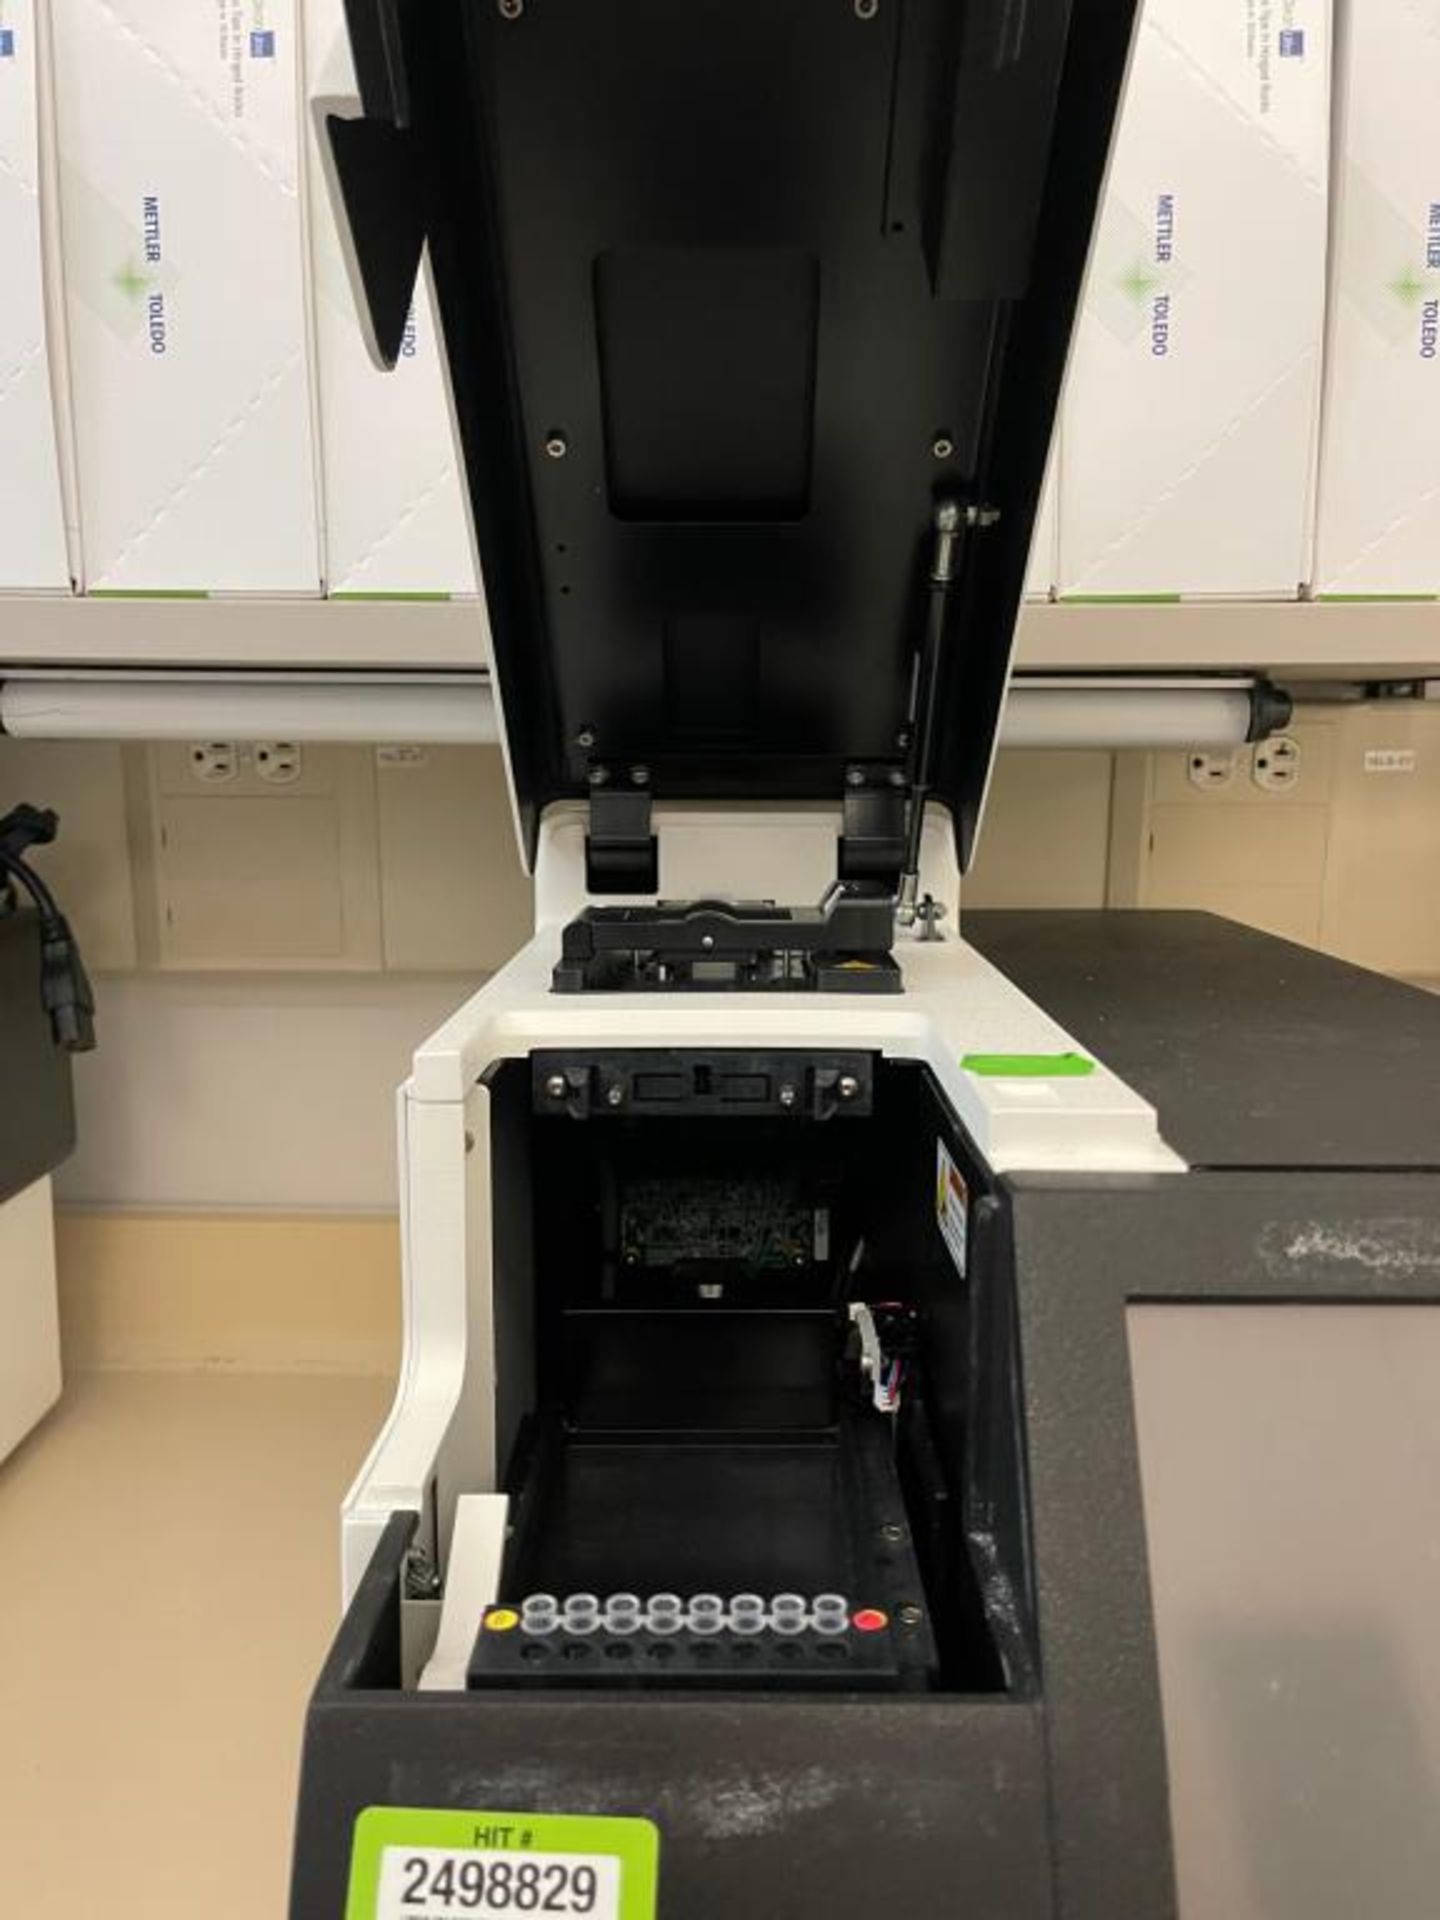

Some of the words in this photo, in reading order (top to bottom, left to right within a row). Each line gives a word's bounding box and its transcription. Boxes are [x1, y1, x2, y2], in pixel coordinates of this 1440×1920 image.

[143, 197, 161, 262] METTLER
[1156, 194, 1174, 263] METTLER
[149, 294, 166, 354] TOLEDO
[1152, 295, 1170, 356] TOLEDO
[1420, 299, 1439, 359] TOLEDO
[473, 1826, 514, 1848] HIT
[519, 1830, 533, 1846] #
[401, 1857, 597, 1913] 2498829
